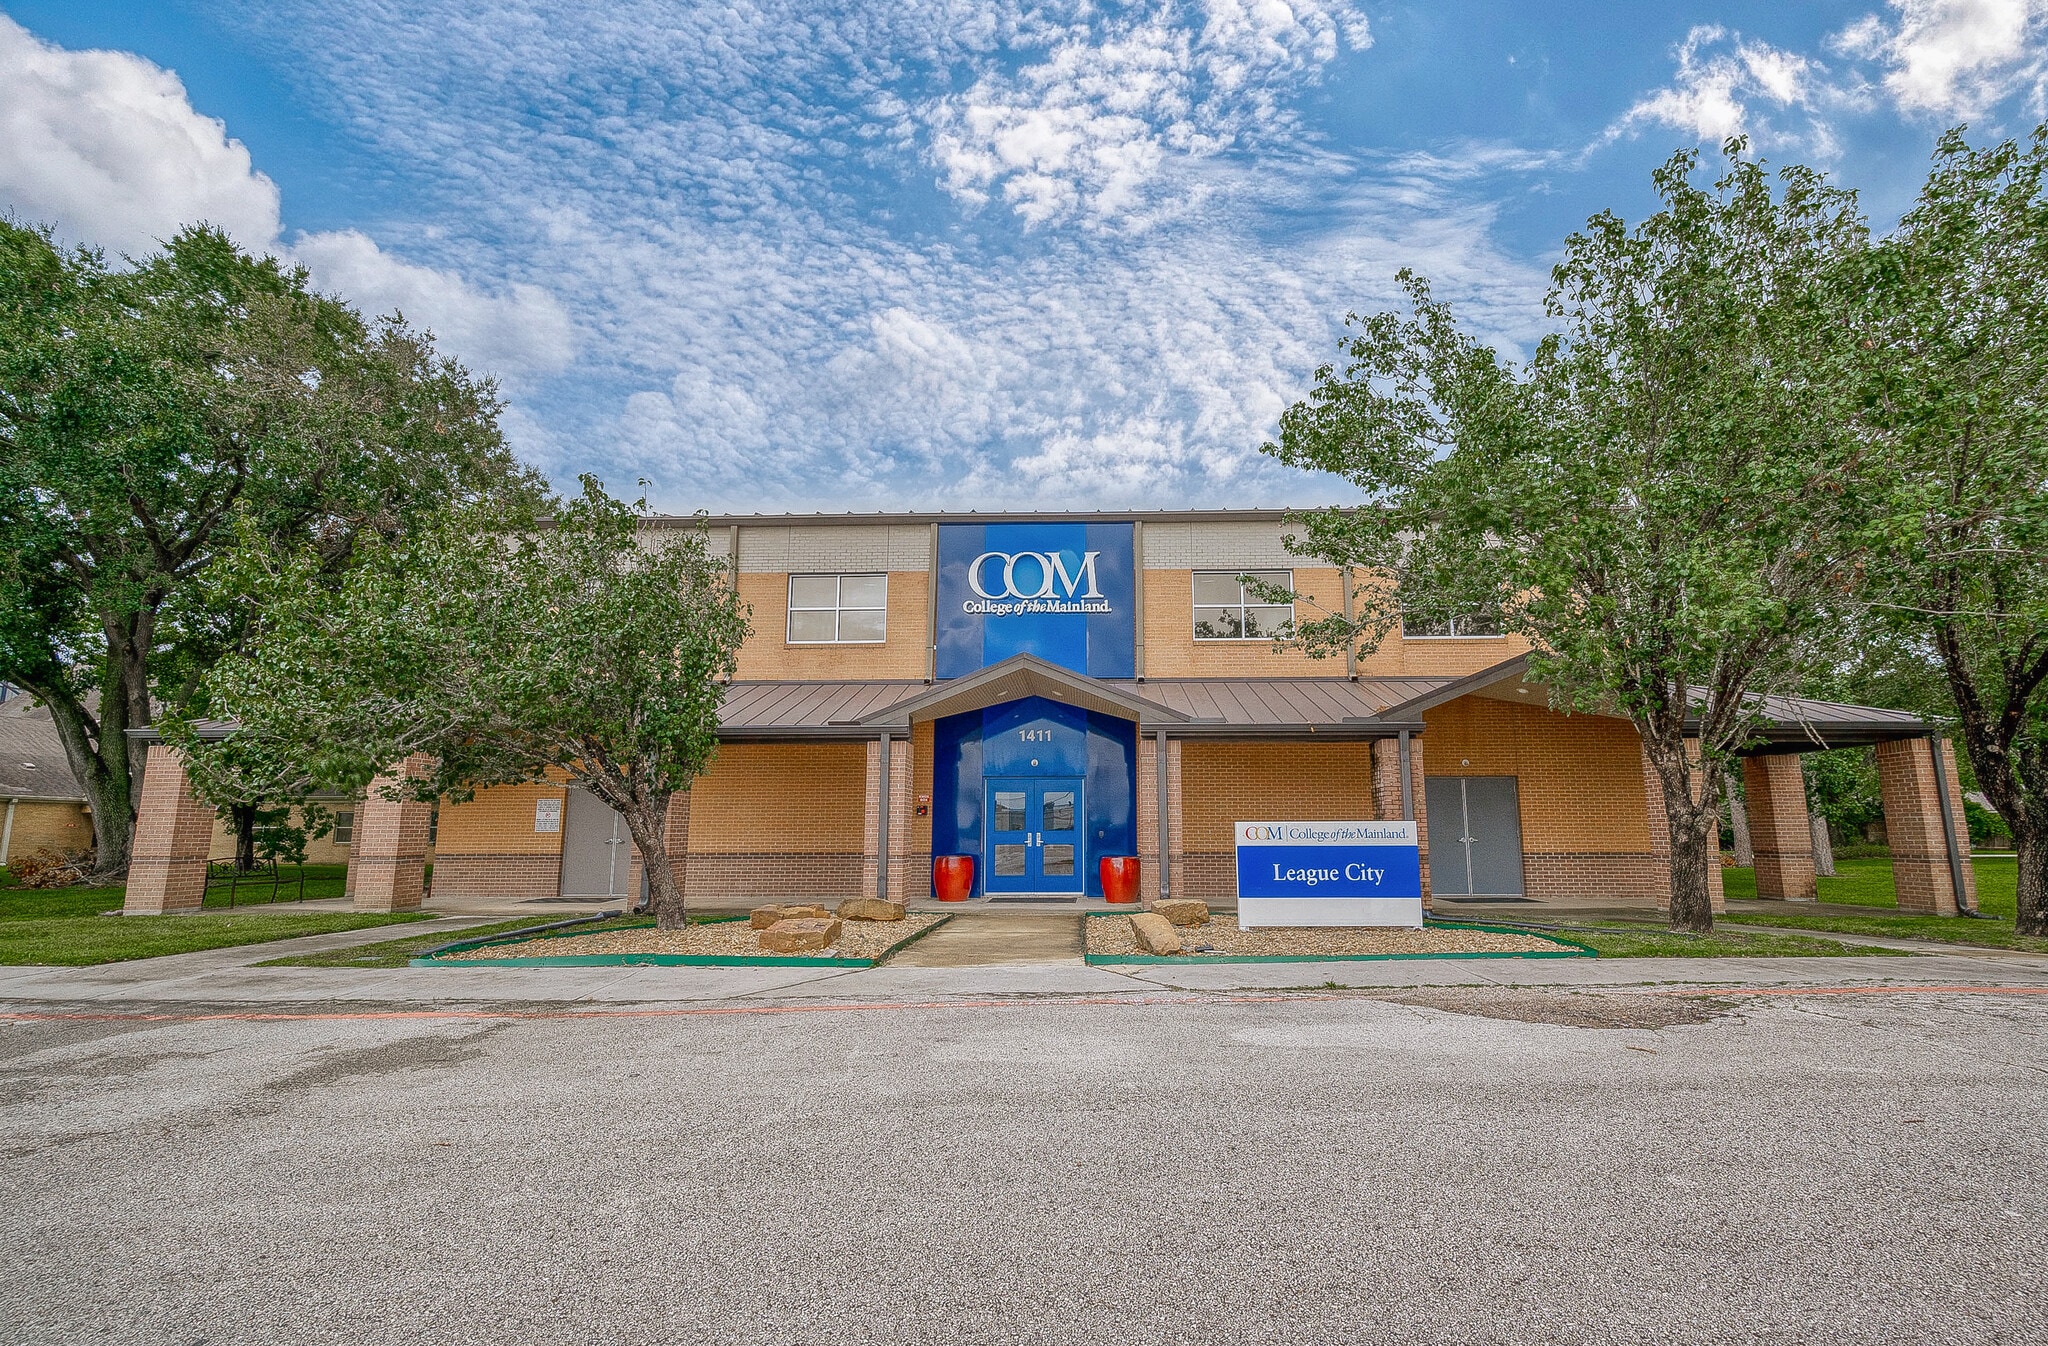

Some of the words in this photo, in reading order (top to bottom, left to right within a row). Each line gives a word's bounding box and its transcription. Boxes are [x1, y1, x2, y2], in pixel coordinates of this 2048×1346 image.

[968, 551, 1104, 599] COM
[962, 600, 1013, 616] College
[1013, 600, 1028, 616] of
[1026, 600, 1047, 613] the
[1018, 729, 1051, 742] 1411
[1245, 826, 1283, 840] COM
[1289, 828, 1330, 842] College
[1330, 828, 1342, 842] of
[1341, 828, 1356, 839] the
[1273, 863, 1339, 886] League
[1344, 863, 1385, 886] City
